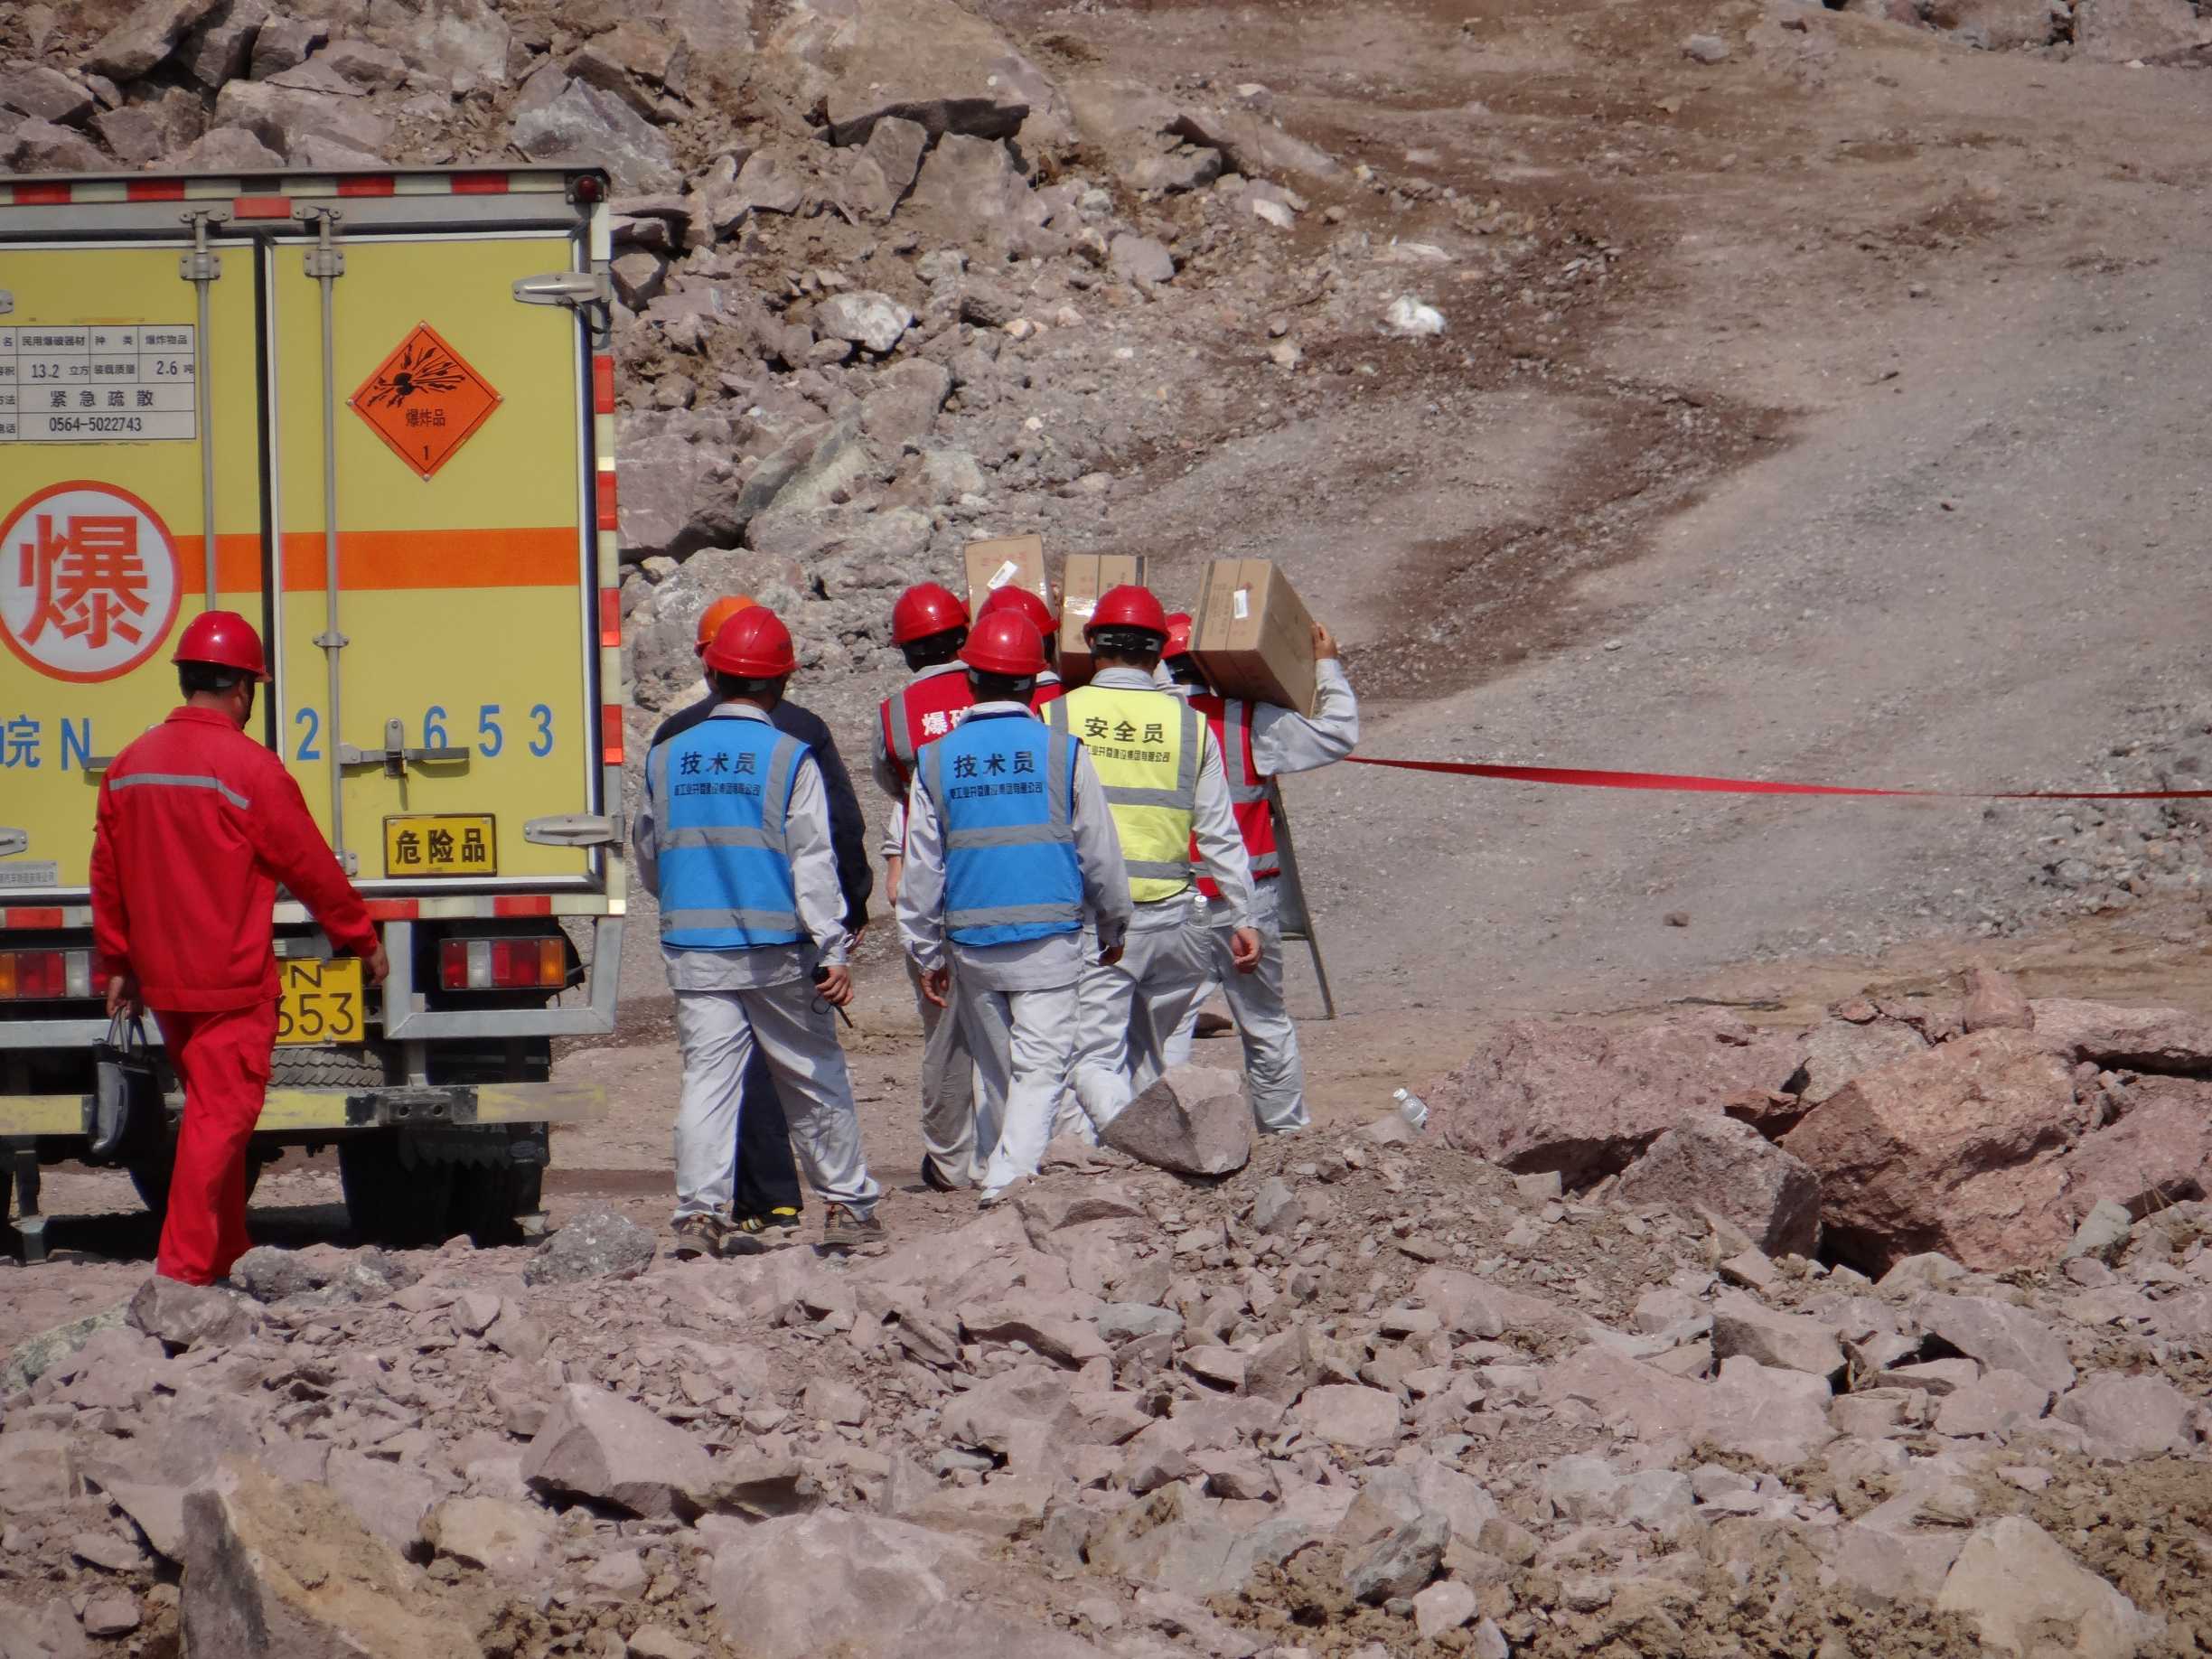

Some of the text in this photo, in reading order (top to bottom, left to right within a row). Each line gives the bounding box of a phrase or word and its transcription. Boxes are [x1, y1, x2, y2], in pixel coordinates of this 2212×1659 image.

[145, 335, 187, 344] 爆炸物品
[32, 364, 89, 378] 13.2 立方
[94, 364, 135, 375] 装载质量
[156, 361, 177, 375] 2.6
[51, 390, 154, 407] 紧急疏散
[50, 417, 142, 432] 0564-5022743
[406, 408, 445, 427] 爆炸品
[423, 445, 429, 460] 1
[18, 514, 150, 649] 爆
[1084, 717, 1165, 744] 安全员
[680, 751, 757, 775] 技术员
[953, 750, 1036, 778] 技术员
[396, 828, 485, 865] 危险品
[290, 964, 322, 989] N
